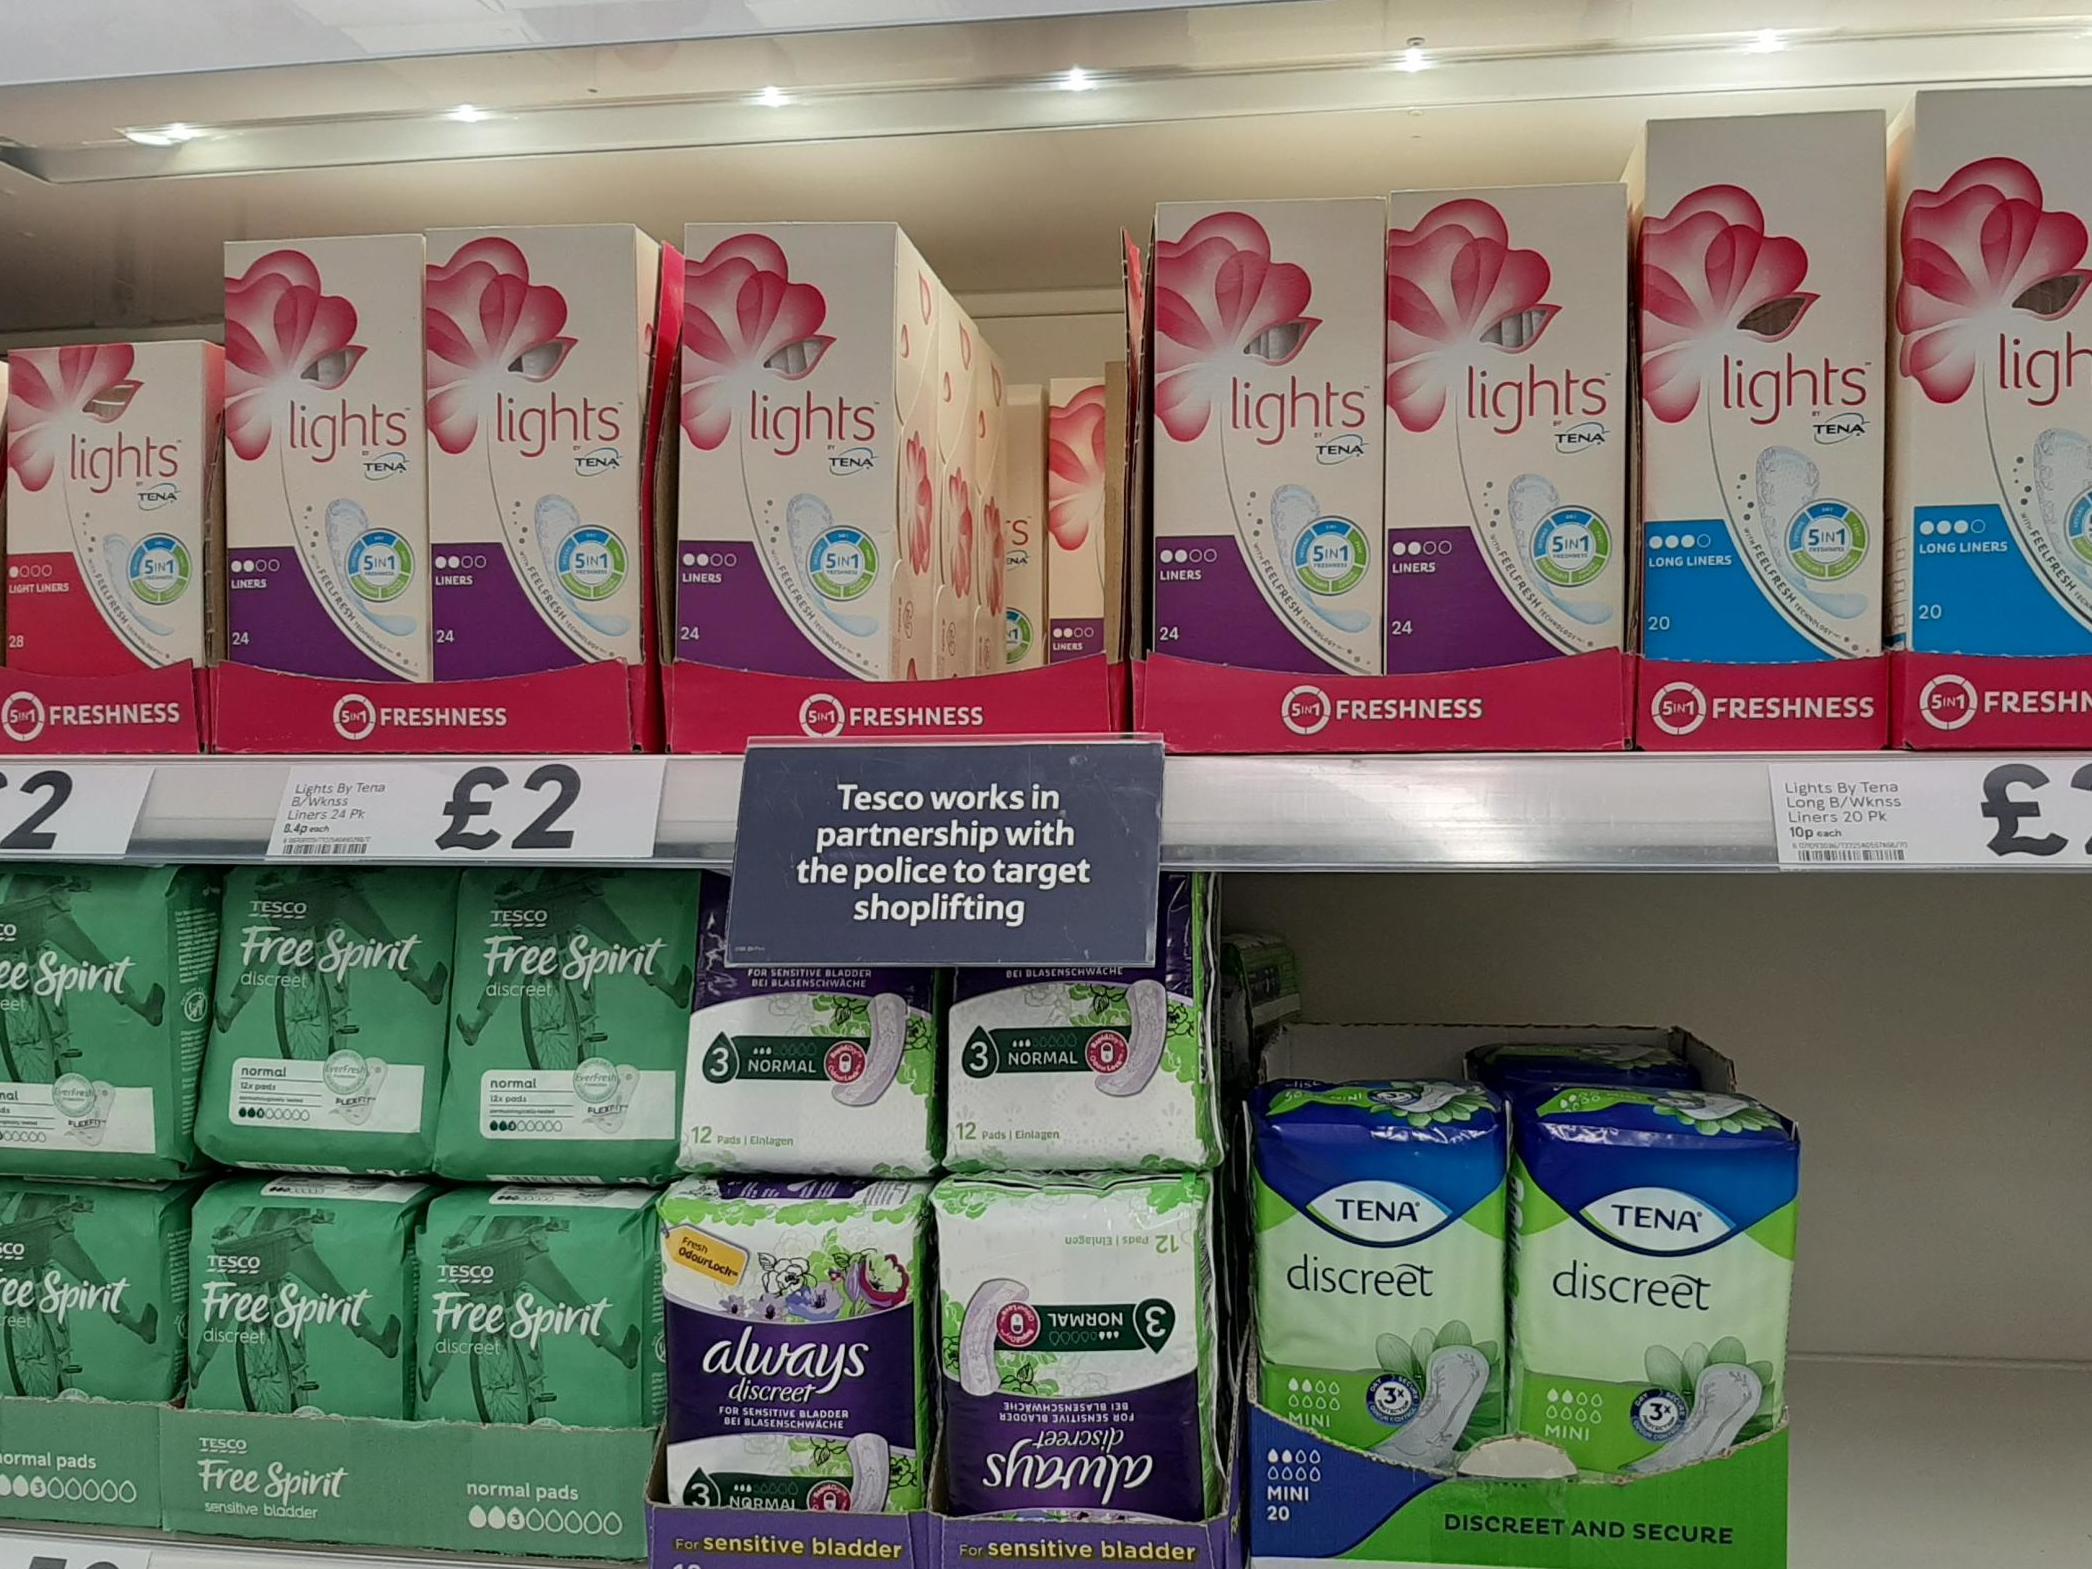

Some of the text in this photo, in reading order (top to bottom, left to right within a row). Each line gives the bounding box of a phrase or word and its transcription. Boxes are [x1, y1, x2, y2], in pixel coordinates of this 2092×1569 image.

[1723, 352, 1866, 425] lights
[1467, 364, 1607, 435] lights
[1231, 376, 1366, 445] lights
[289, 399, 408, 463] lights
[497, 392, 621, 458] lights
[750, 390, 876, 456] lights
[71, 432, 178, 494] lights
[1919, 541, 2009, 554] LONG LINERS
[1392, 562, 1436, 573] LINERS
[1649, 555, 1732, 568] LONG LINERS
[2030, 529, 2077, 592] FEELFRESH
[231, 579, 267, 589] LINERS
[435, 576, 473, 586] LINERS
[682, 573, 722, 584] LINERS
[1160, 570, 1202, 581] LINERS
[9, 583, 70, 594] LIGHT LINERS
[1919, 605, 1942, 620] 20
[1392, 620, 1413, 635] 24
[1649, 617, 1670, 631] 20
[9, 635, 24, 648] 28
[232, 632, 250, 645] 24
[436, 630, 454, 643] 24
[680, 627, 700, 640] 24
[1160, 627, 1179, 641] 24
[50, 703, 180, 725] FRESHNESS
[849, 706, 985, 727] FRESHNESS
[1336, 698, 1483, 720] FRESHNESS
[1712, 697, 1875, 719] FRESHNESS
[380, 707, 507, 727] FRESHNESS
[295, 782, 386, 797] Lights By Tena
[838, 783, 1060, 812] Tesco works in
[1785, 781, 1899, 797] Lights By Tena
[291, 796, 349, 807] B/Wknss
[434, 763, 581, 851] £2
[1786, 796, 1902, 811] Long B/Wknss
[288, 808, 366, 821] Liners 24 Pk
[1788, 811, 1887, 823] Liners 20 Pk
[283, 823, 330, 835] 8.4p each
[816, 819, 1074, 853] partnership with
[1789, 826, 1842, 841] 10p each
[797, 857, 1091, 889] the police to target
[251, 901, 307, 915] TESCO
[490, 910, 548, 923] TESCO
[853, 893, 1026, 926] shoplifting
[241, 926, 315, 967] Free
[318, 928, 423, 983] Spirit
[483, 936, 559, 976] Free
[563, 935, 668, 991] Spirit
[34, 950, 137, 1007] Spirit
[241, 972, 308, 989] discreet
[748, 968, 872, 978] FOR SENSITIVE BLADDER
[486, 984, 552, 997] discreet
[709, 1047, 729, 1077] 3
[968, 1041, 989, 1072] 3
[1008, 1052, 1078, 1066] NORMAL
[241, 1067, 287, 1078] normal
[748, 1059, 816, 1074] NORMAL
[490, 1078, 537, 1089] normal
[691, 1127, 794, 1148] 12 Pads Einlagen
[955, 1122, 1060, 1141] 12 Pads Einlagen
[1336, 1198, 1418, 1223] TENA
[1611, 1204, 1700, 1233] TENA
[682, 1236, 708, 1254] Fresh
[1065, 1234, 1180, 1254] 12 Pads Einlagen
[207, 1255, 261, 1270] TESCO
[437, 1265, 494, 1279] TESCO
[1287, 1253, 1433, 1297] discreet
[1552, 1259, 1711, 1311] discreet
[39, 1270, 131, 1323] Spirit
[202, 1282, 374, 1339] Free Spirit
[432, 1291, 613, 1351] Free Spirit
[1048, 1312, 1124, 1327] NORMAL
[1144, 1305, 1167, 1338] 3
[203, 1327, 265, 1345] discreet
[435, 1340, 501, 1356] discreet
[702, 1326, 870, 1394] always
[728, 1378, 815, 1403] discreet
[719, 1406, 849, 1419] FOR SENSITIVE BLADDER
[1111, 1402, 1129, 1411] BEI
[723, 1416, 844, 1429] BEI BLASENSCHWÄCHE
[999, 1412, 1135, 1423] FOR SENSITIVE BLADDER
[1289, 1411, 1330, 1428] MINI
[1545, 1424, 1590, 1441] MINI
[199, 1438, 247, 1451] TESCO
[1032, 1430, 1124, 1453] discreet
[56, 1453, 97, 1471] pads
[982, 1438, 1154, 1506] always
[34, 1482, 43, 1493] 3
[197, 1459, 349, 1506] Free Spirit
[466, 1482, 579, 1502] normal pads
[690, 1482, 711, 1507] 3
[1267, 1486, 1309, 1501] MINI
[204, 1501, 318, 1520] sensitive bladder
[1267, 1506, 1290, 1521] 20
[511, 1514, 521, 1526] 3
[1445, 1513, 1734, 1545] DISCREET AND SECURE
[675, 1534, 902, 1558] For sensitive bladder
[959, 1539, 1197, 1562] For sensitive bladder
